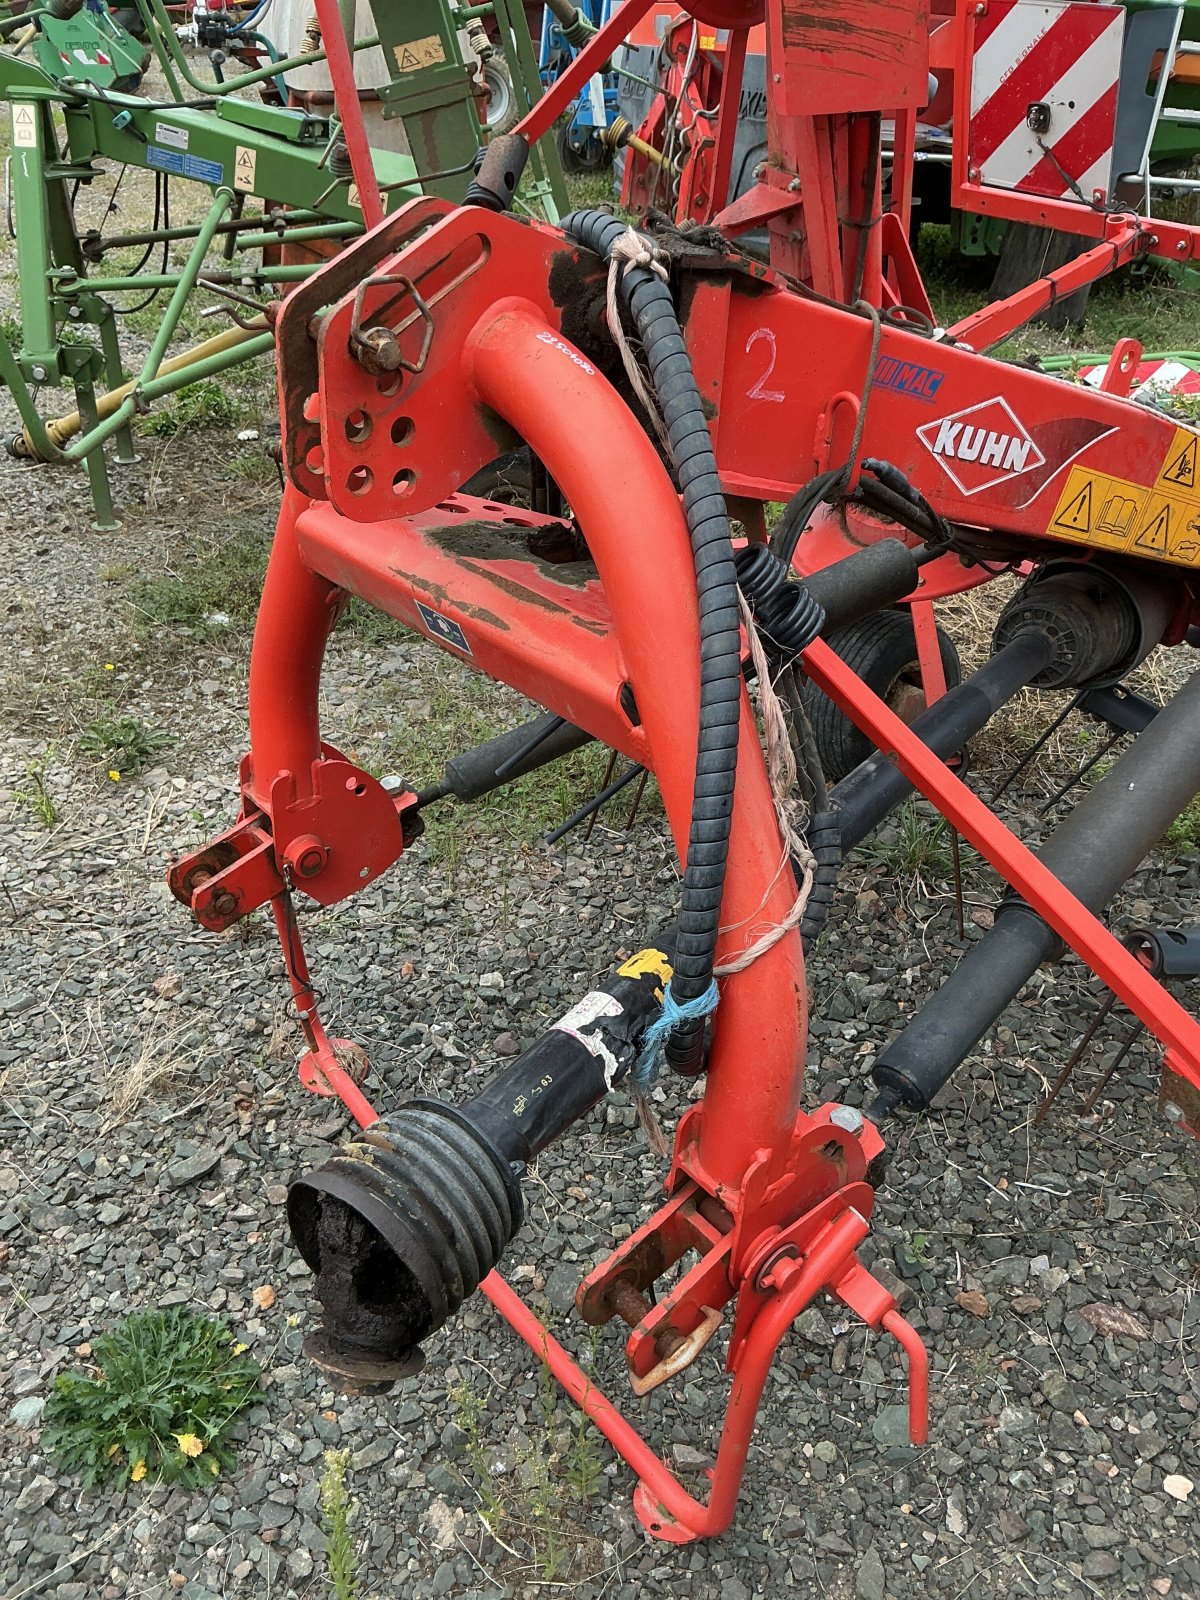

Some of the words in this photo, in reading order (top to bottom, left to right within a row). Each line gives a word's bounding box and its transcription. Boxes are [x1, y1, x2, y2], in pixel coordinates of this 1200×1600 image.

[999, 65, 1014, 83] CFG
[745, 327, 785, 403] 2
[932, 419, 1032, 473] KUHN
